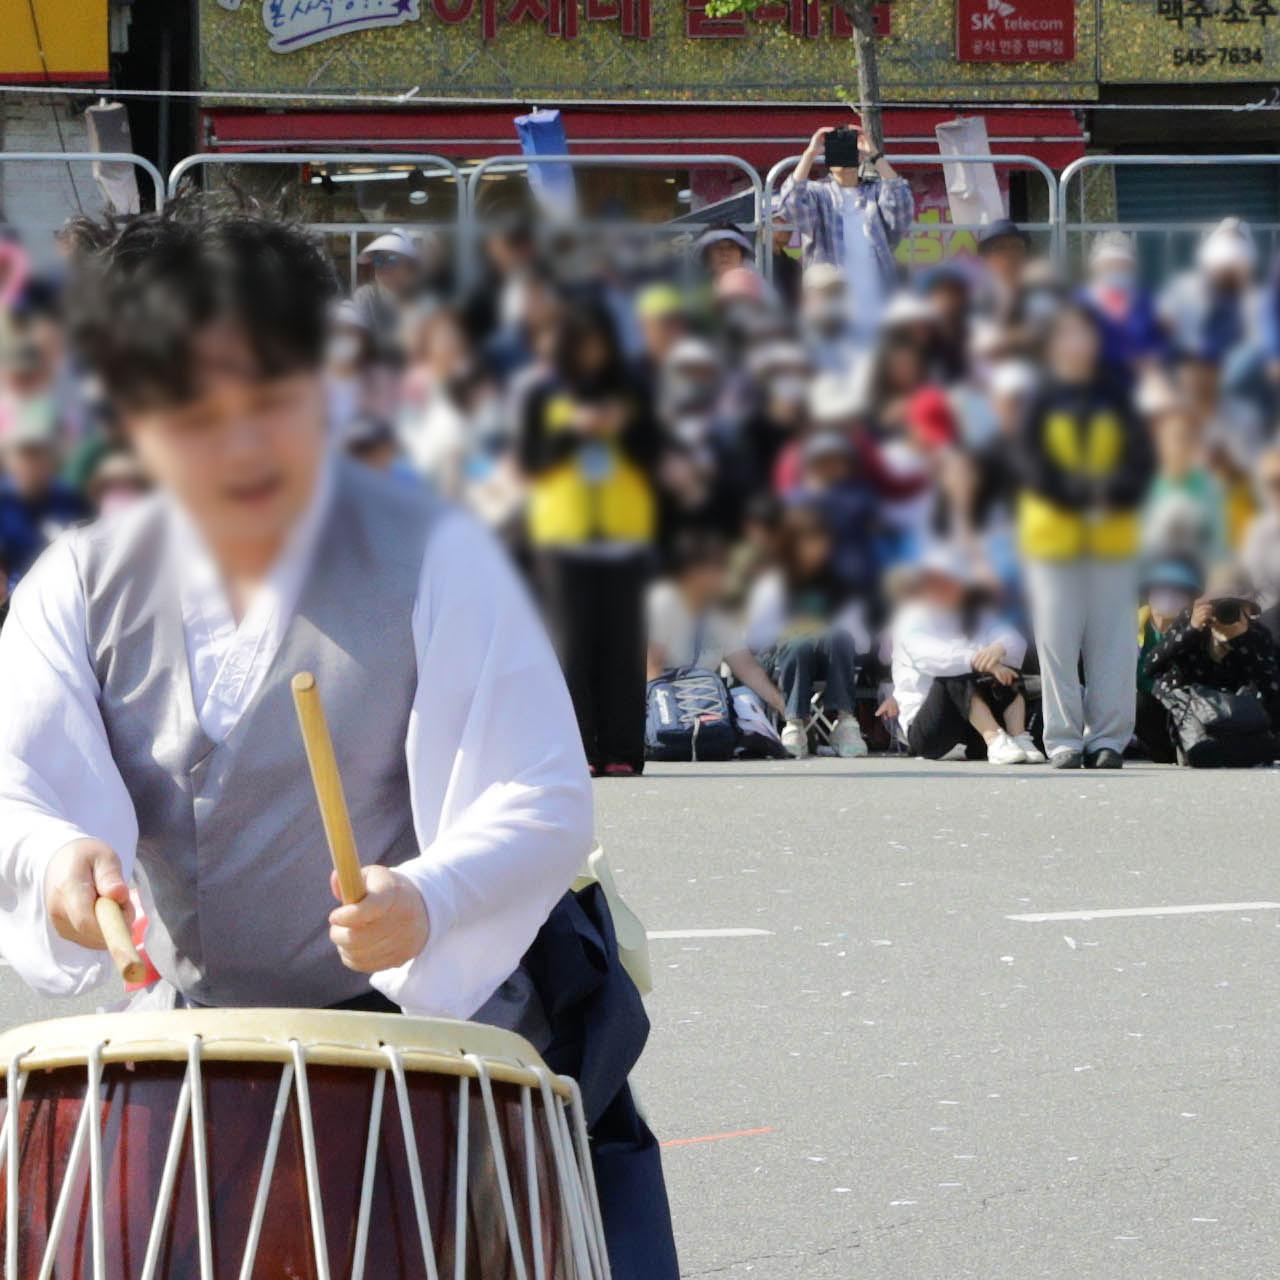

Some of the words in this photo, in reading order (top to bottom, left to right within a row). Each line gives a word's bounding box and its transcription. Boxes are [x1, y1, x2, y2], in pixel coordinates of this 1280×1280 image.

[971, 12, 995, 30] SK
[1004, 16, 1063, 30] telecom
[1173, 47, 1264, 66] 545-7634
